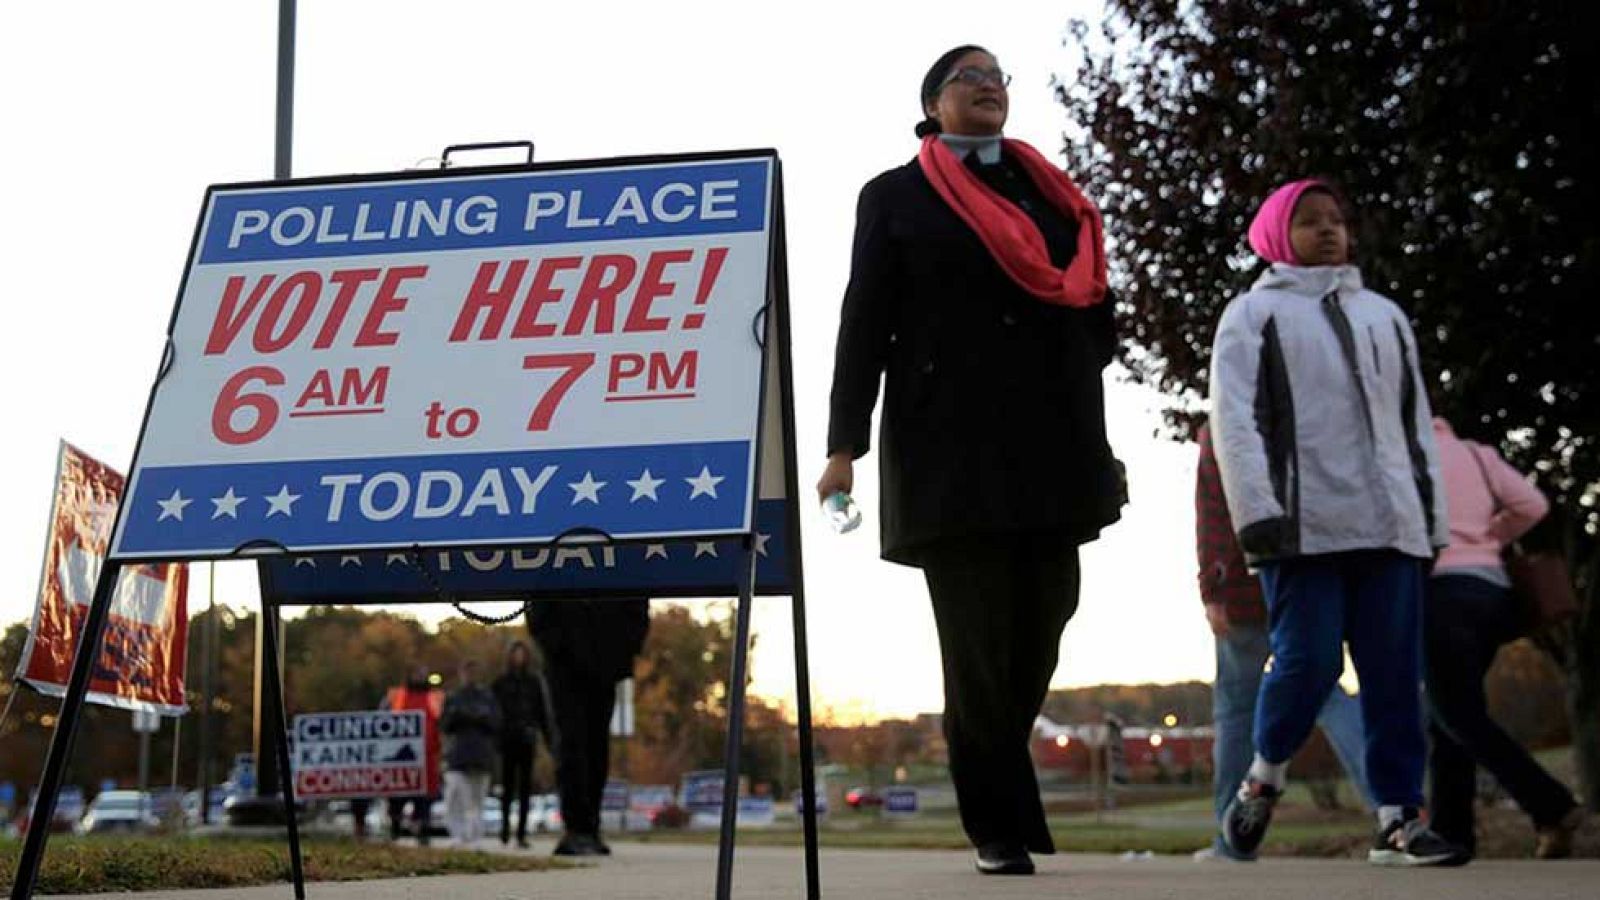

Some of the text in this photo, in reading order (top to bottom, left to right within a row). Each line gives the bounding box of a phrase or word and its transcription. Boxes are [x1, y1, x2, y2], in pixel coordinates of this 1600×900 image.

[227, 179, 740, 248] POLLING PLACE
[203, 247, 730, 356] VOTE HERE!
[211, 350, 699, 445] 6 AM to 7 PM
[319, 464, 559, 522] TODAY
[301, 714, 419, 740] CLINTON
[301, 744, 379, 763] KAINE
[299, 767, 418, 793] CONNOLLY
